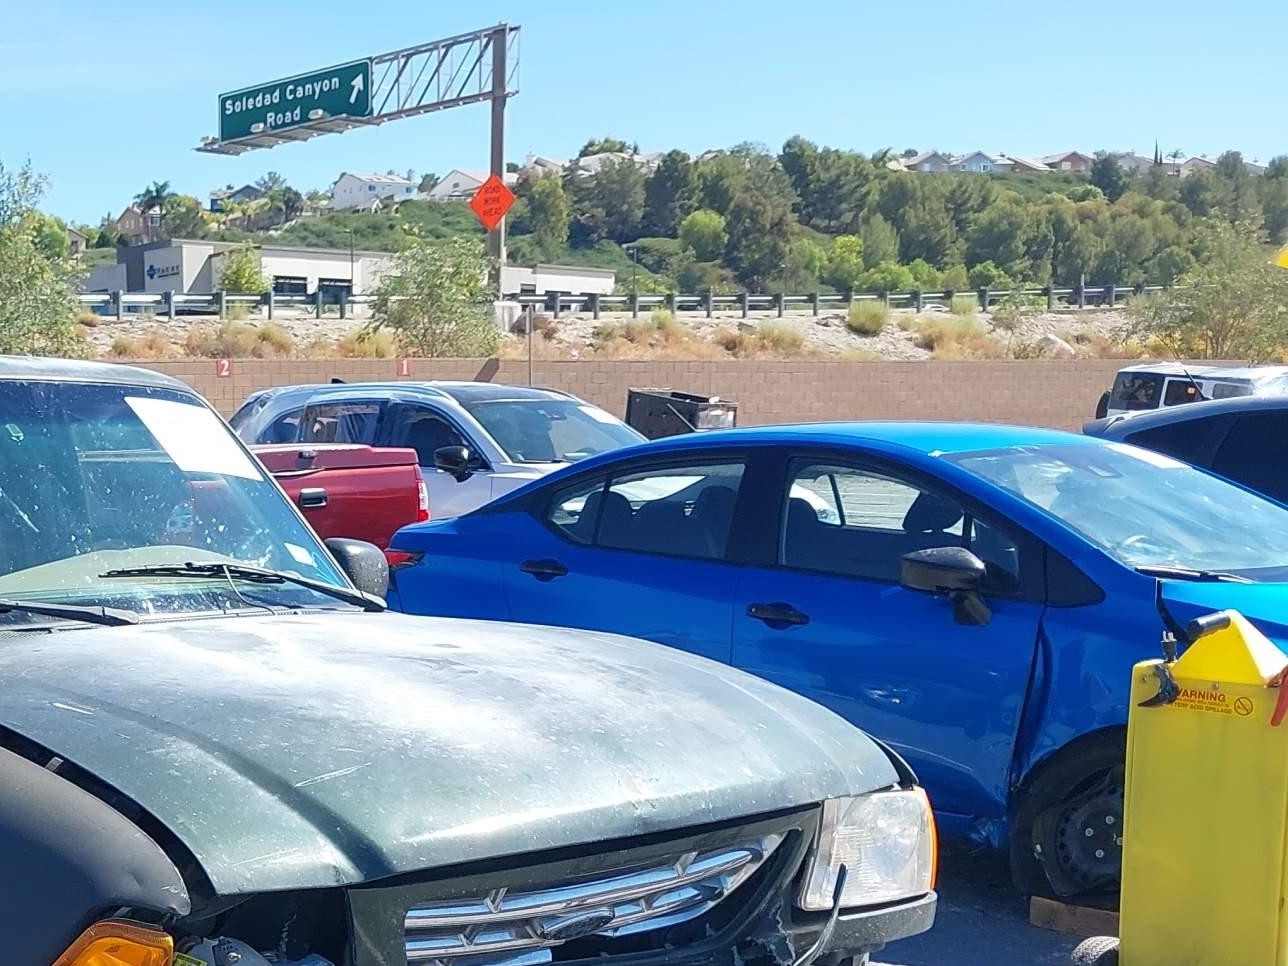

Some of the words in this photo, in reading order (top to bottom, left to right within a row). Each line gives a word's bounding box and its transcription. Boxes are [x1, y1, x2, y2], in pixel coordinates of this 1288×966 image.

[225, 88, 280, 115] Soledad
[286, 77, 340, 100] Canyon
[266, 106, 301, 128] Road
[220, 359, 230, 375] 2
[401, 359, 409, 375] 1
